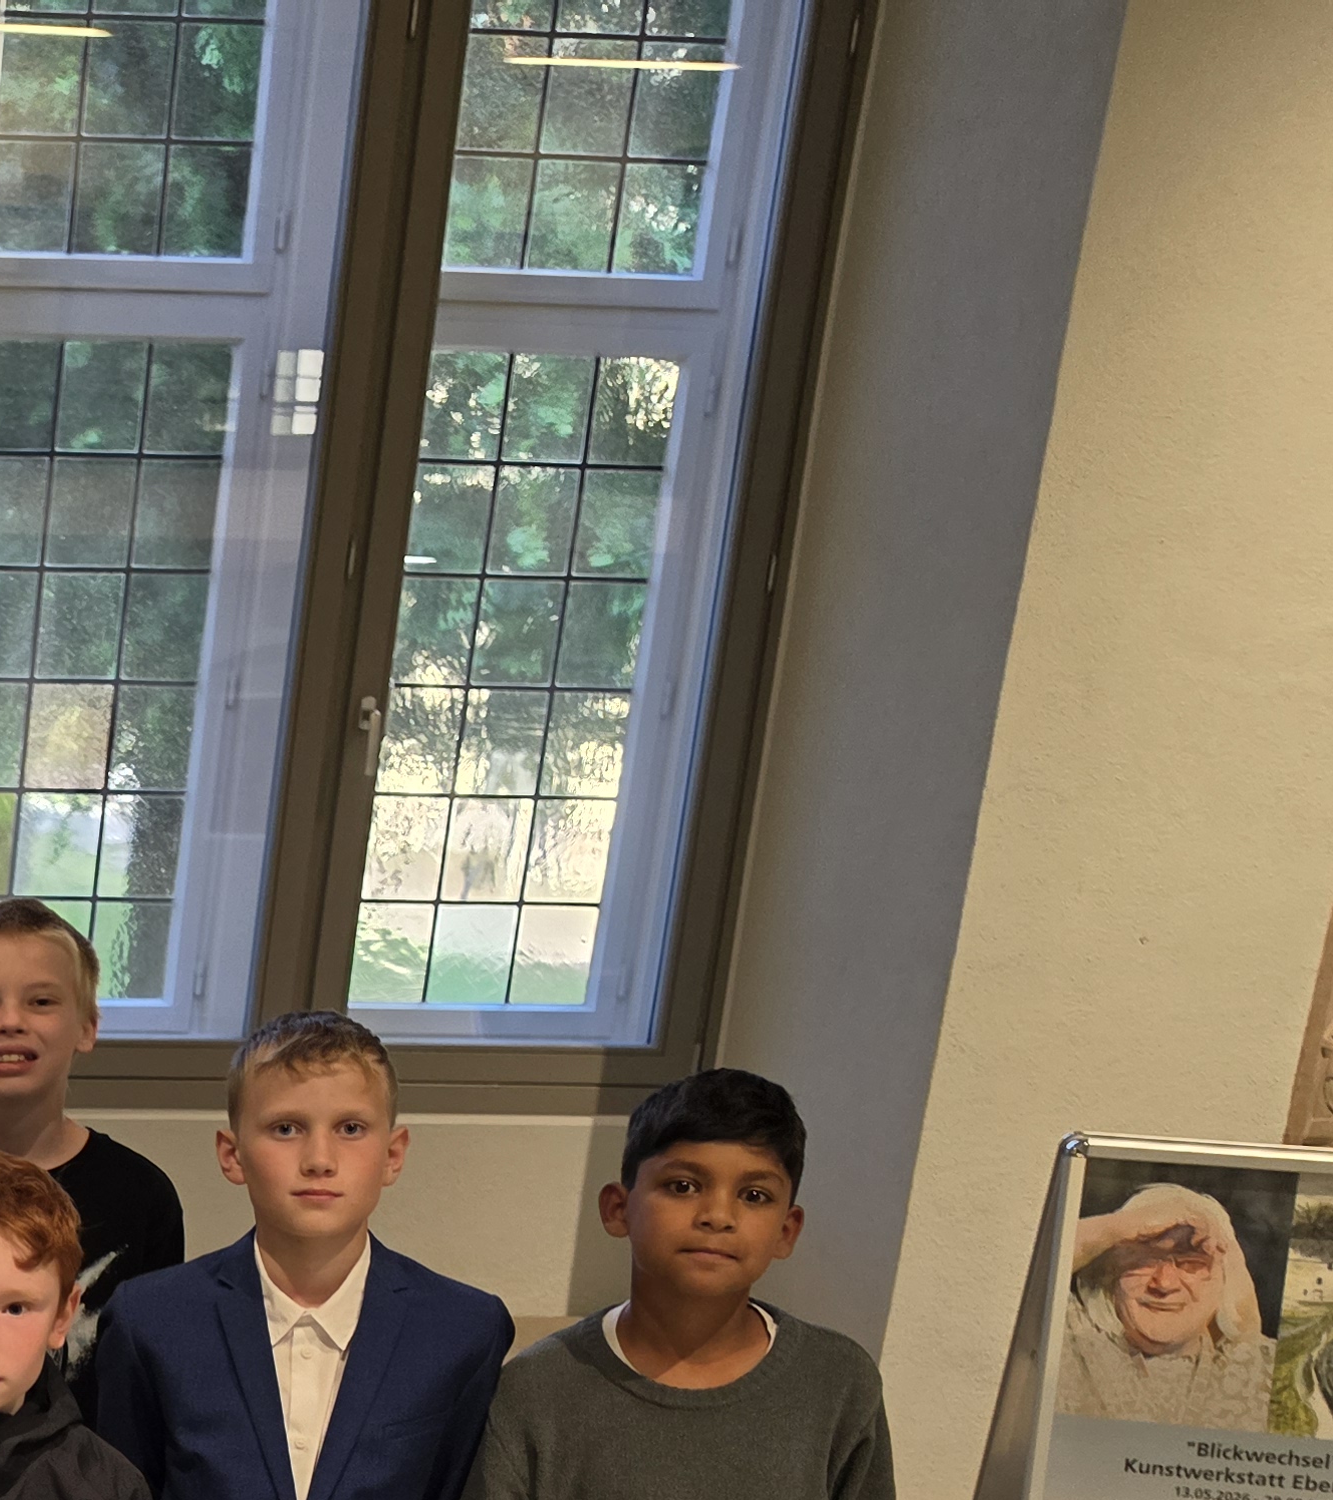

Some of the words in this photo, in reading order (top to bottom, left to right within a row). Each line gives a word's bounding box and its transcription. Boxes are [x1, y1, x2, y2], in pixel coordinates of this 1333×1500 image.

[1187, 1440, 1333, 1470] "Blickwechsel
[1124, 1458, 1286, 1489] Kunstwerkstatt
[1292, 1474, 1333, 1494] Ebe
